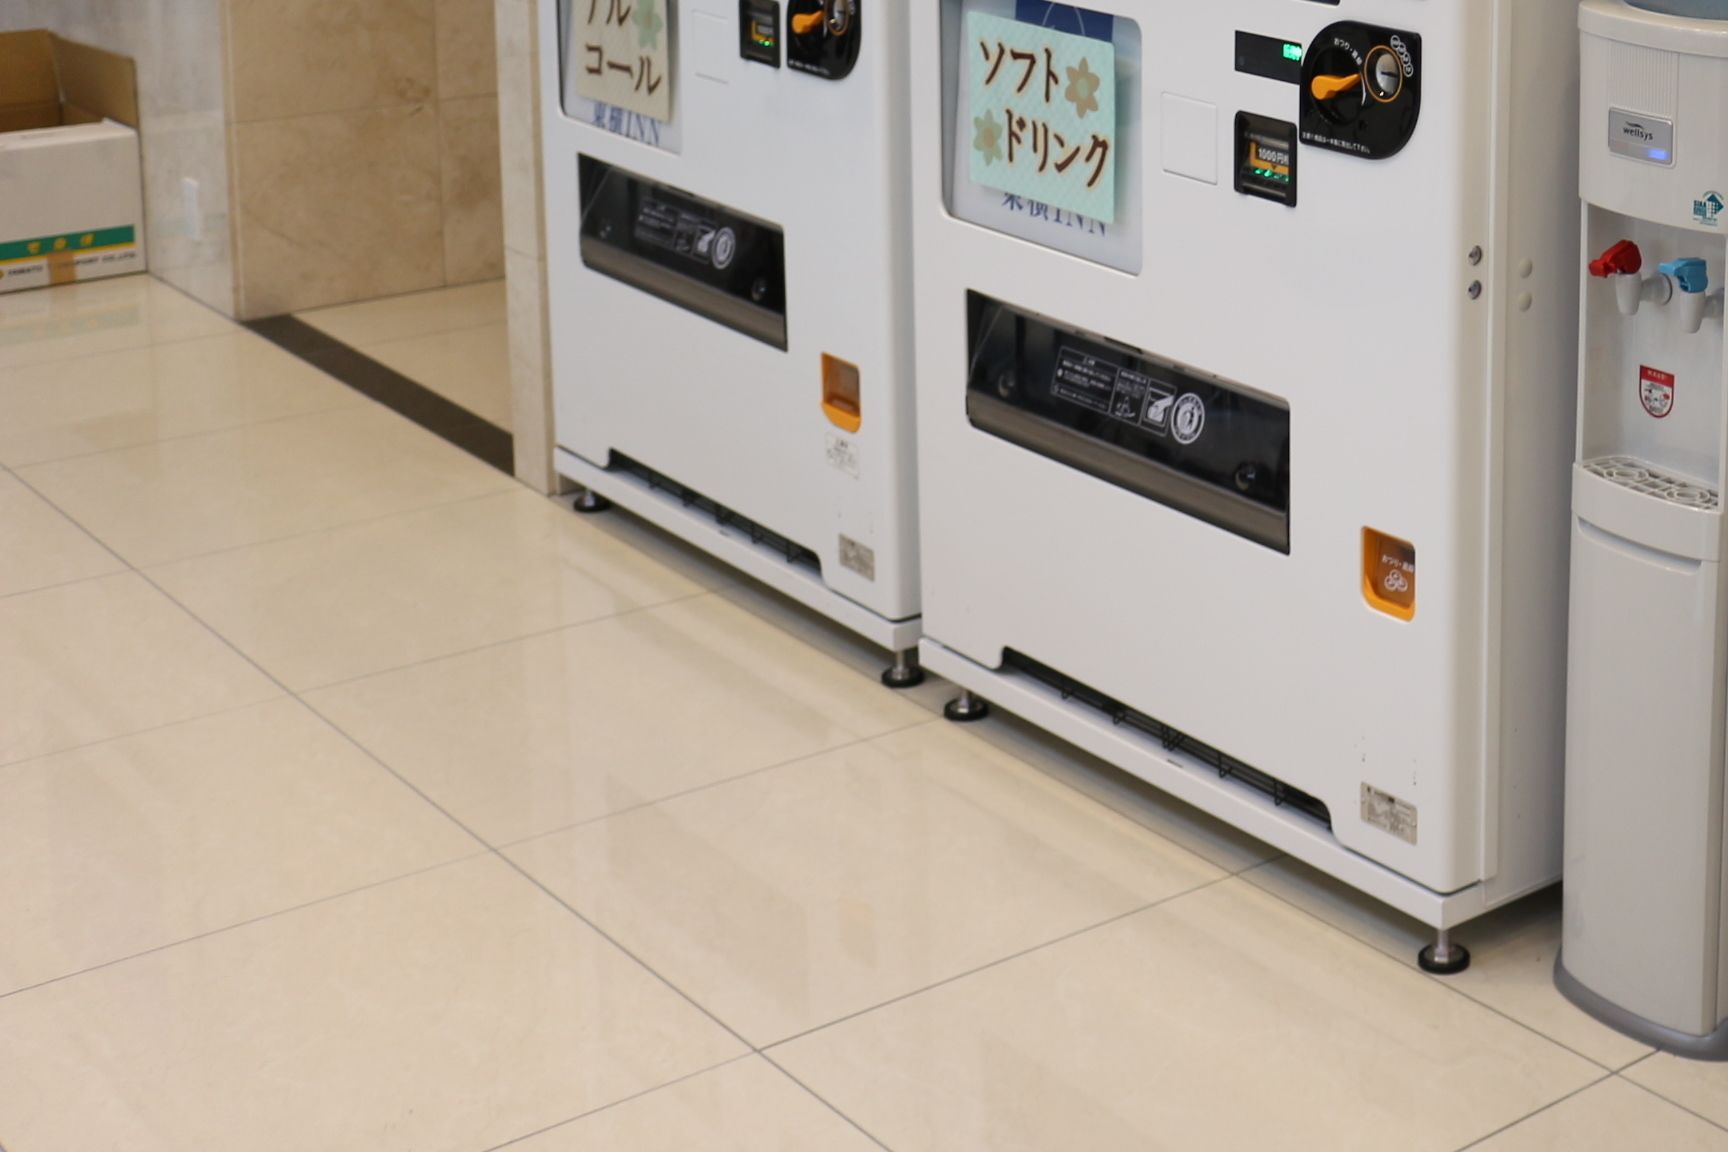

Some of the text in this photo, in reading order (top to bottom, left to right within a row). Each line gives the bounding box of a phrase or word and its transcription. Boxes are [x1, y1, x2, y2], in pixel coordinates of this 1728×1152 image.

[585, 43, 662, 95] コール
[979, 39, 1059, 104] ソフト
[1003, 108, 1109, 189] ドリンク
[1623, 127, 1653, 141] wellsys
